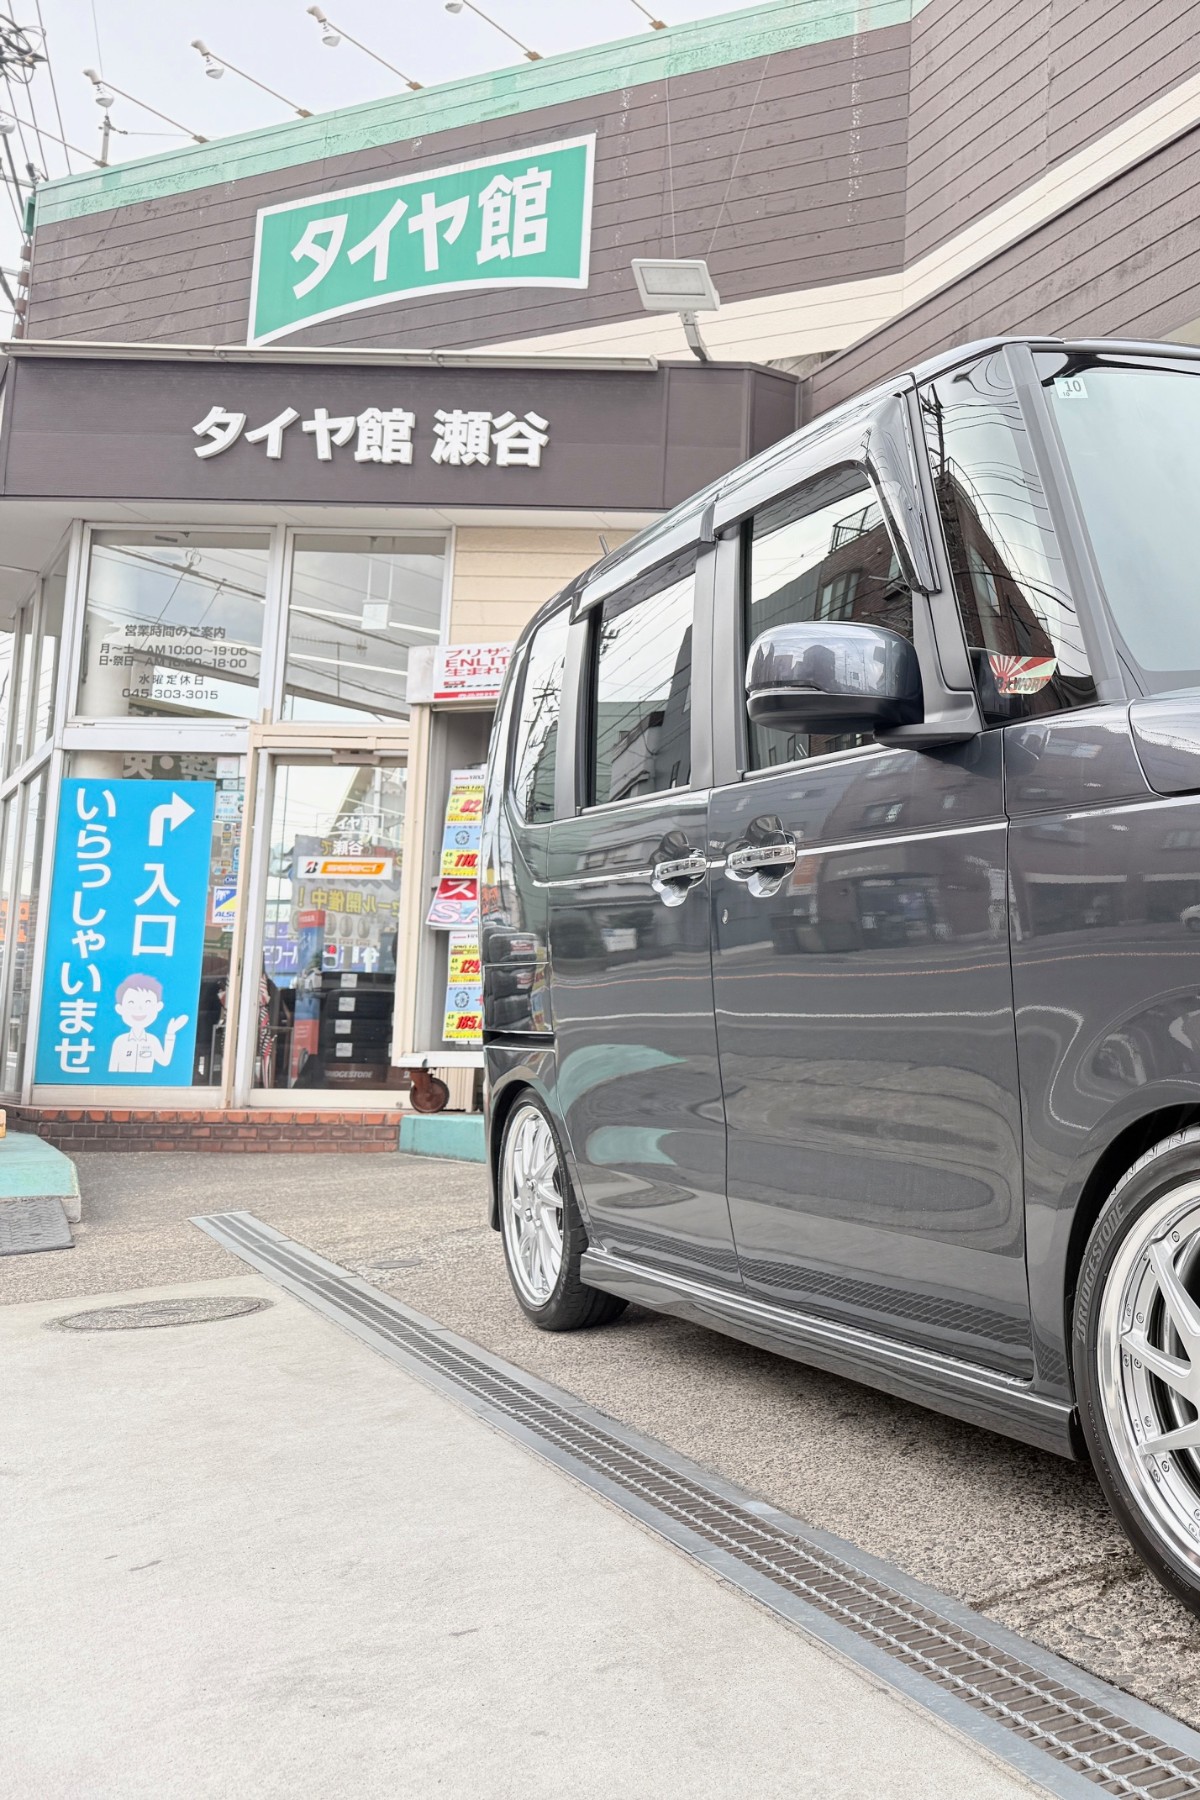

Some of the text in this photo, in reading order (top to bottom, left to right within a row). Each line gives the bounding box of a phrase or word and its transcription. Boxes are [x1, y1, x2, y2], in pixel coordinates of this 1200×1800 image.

[291, 166, 552, 299] タイヤ館
[1064, 380, 1081, 392] 10
[192, 406, 551, 467] タイヤ館 瀬谷
[124, 624, 227, 639] 営業時間のご案内
[138, 674, 205, 686] 水曜定休日
[445, 665, 506, 677] 生まれ
[122, 688, 219, 700] 045-303-3015
[132, 863, 180, 957] 入口
[54, 787, 116, 1074] いらっしゃいませ
[1075, 1199, 1125, 1344] BRIDGESTONE
